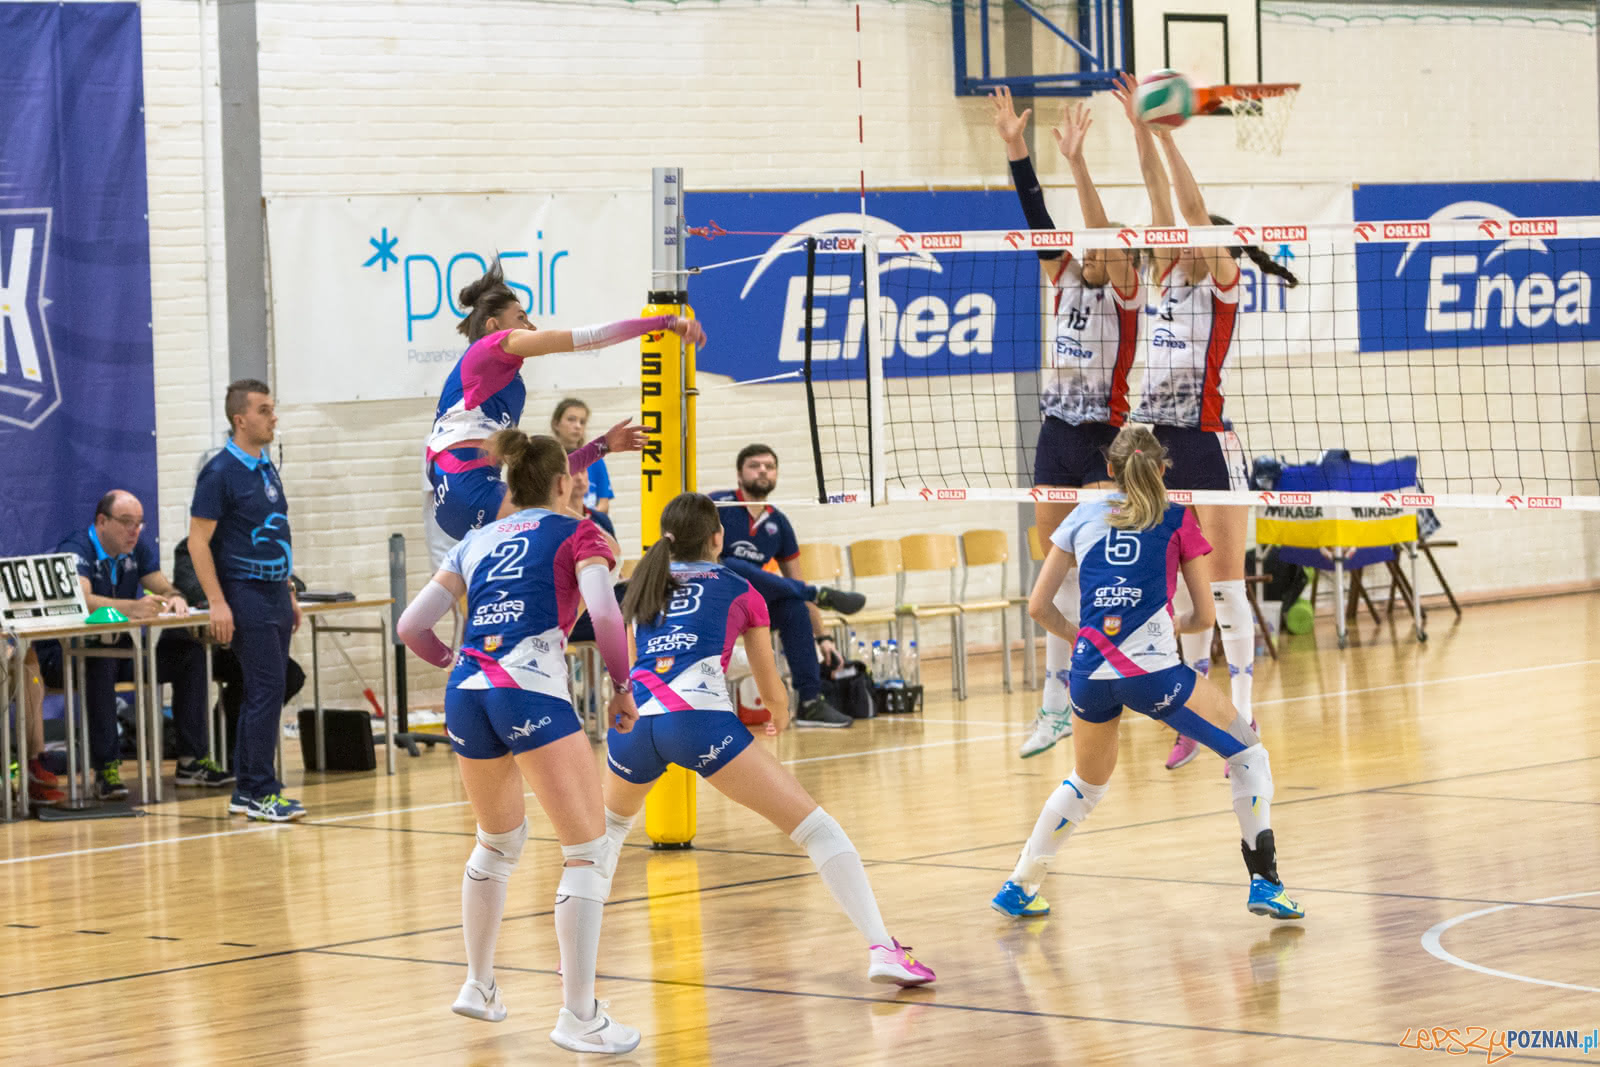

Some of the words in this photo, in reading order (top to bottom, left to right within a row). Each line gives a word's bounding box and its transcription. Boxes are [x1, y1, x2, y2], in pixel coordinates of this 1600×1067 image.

[814, 235, 856, 250] netex
[922, 234, 962, 248] ORLEN
[1033, 233, 1071, 245] ORLEN
[1146, 231, 1187, 243] ORLEN
[1263, 228, 1305, 241] ORLEN
[1384, 224, 1428, 238] ORLEN
[1511, 221, 1556, 235] ORLEN
[1424, 254, 1592, 333] Enea
[778, 274, 997, 362] Enea
[1056, 343, 1093, 359] Enea
[1152, 335, 1186, 349] Enea
[641, 352, 662, 493] SPORT
[827, 493, 857, 504] netex
[938, 490, 966, 500] ORLEN
[1048, 490, 1077, 500] ORLEN
[1167, 491, 1192, 503] RLEN
[1281, 494, 1311, 504] ORLEN
[1402, 496, 1434, 506] ORLEN
[1529, 498, 1561, 508] ORLEN
[1265, 505, 1324, 519] MIKASA
[485, 536, 529, 583] 2
[2, 563, 34, 600] 16
[38, 560, 72, 596] 13
